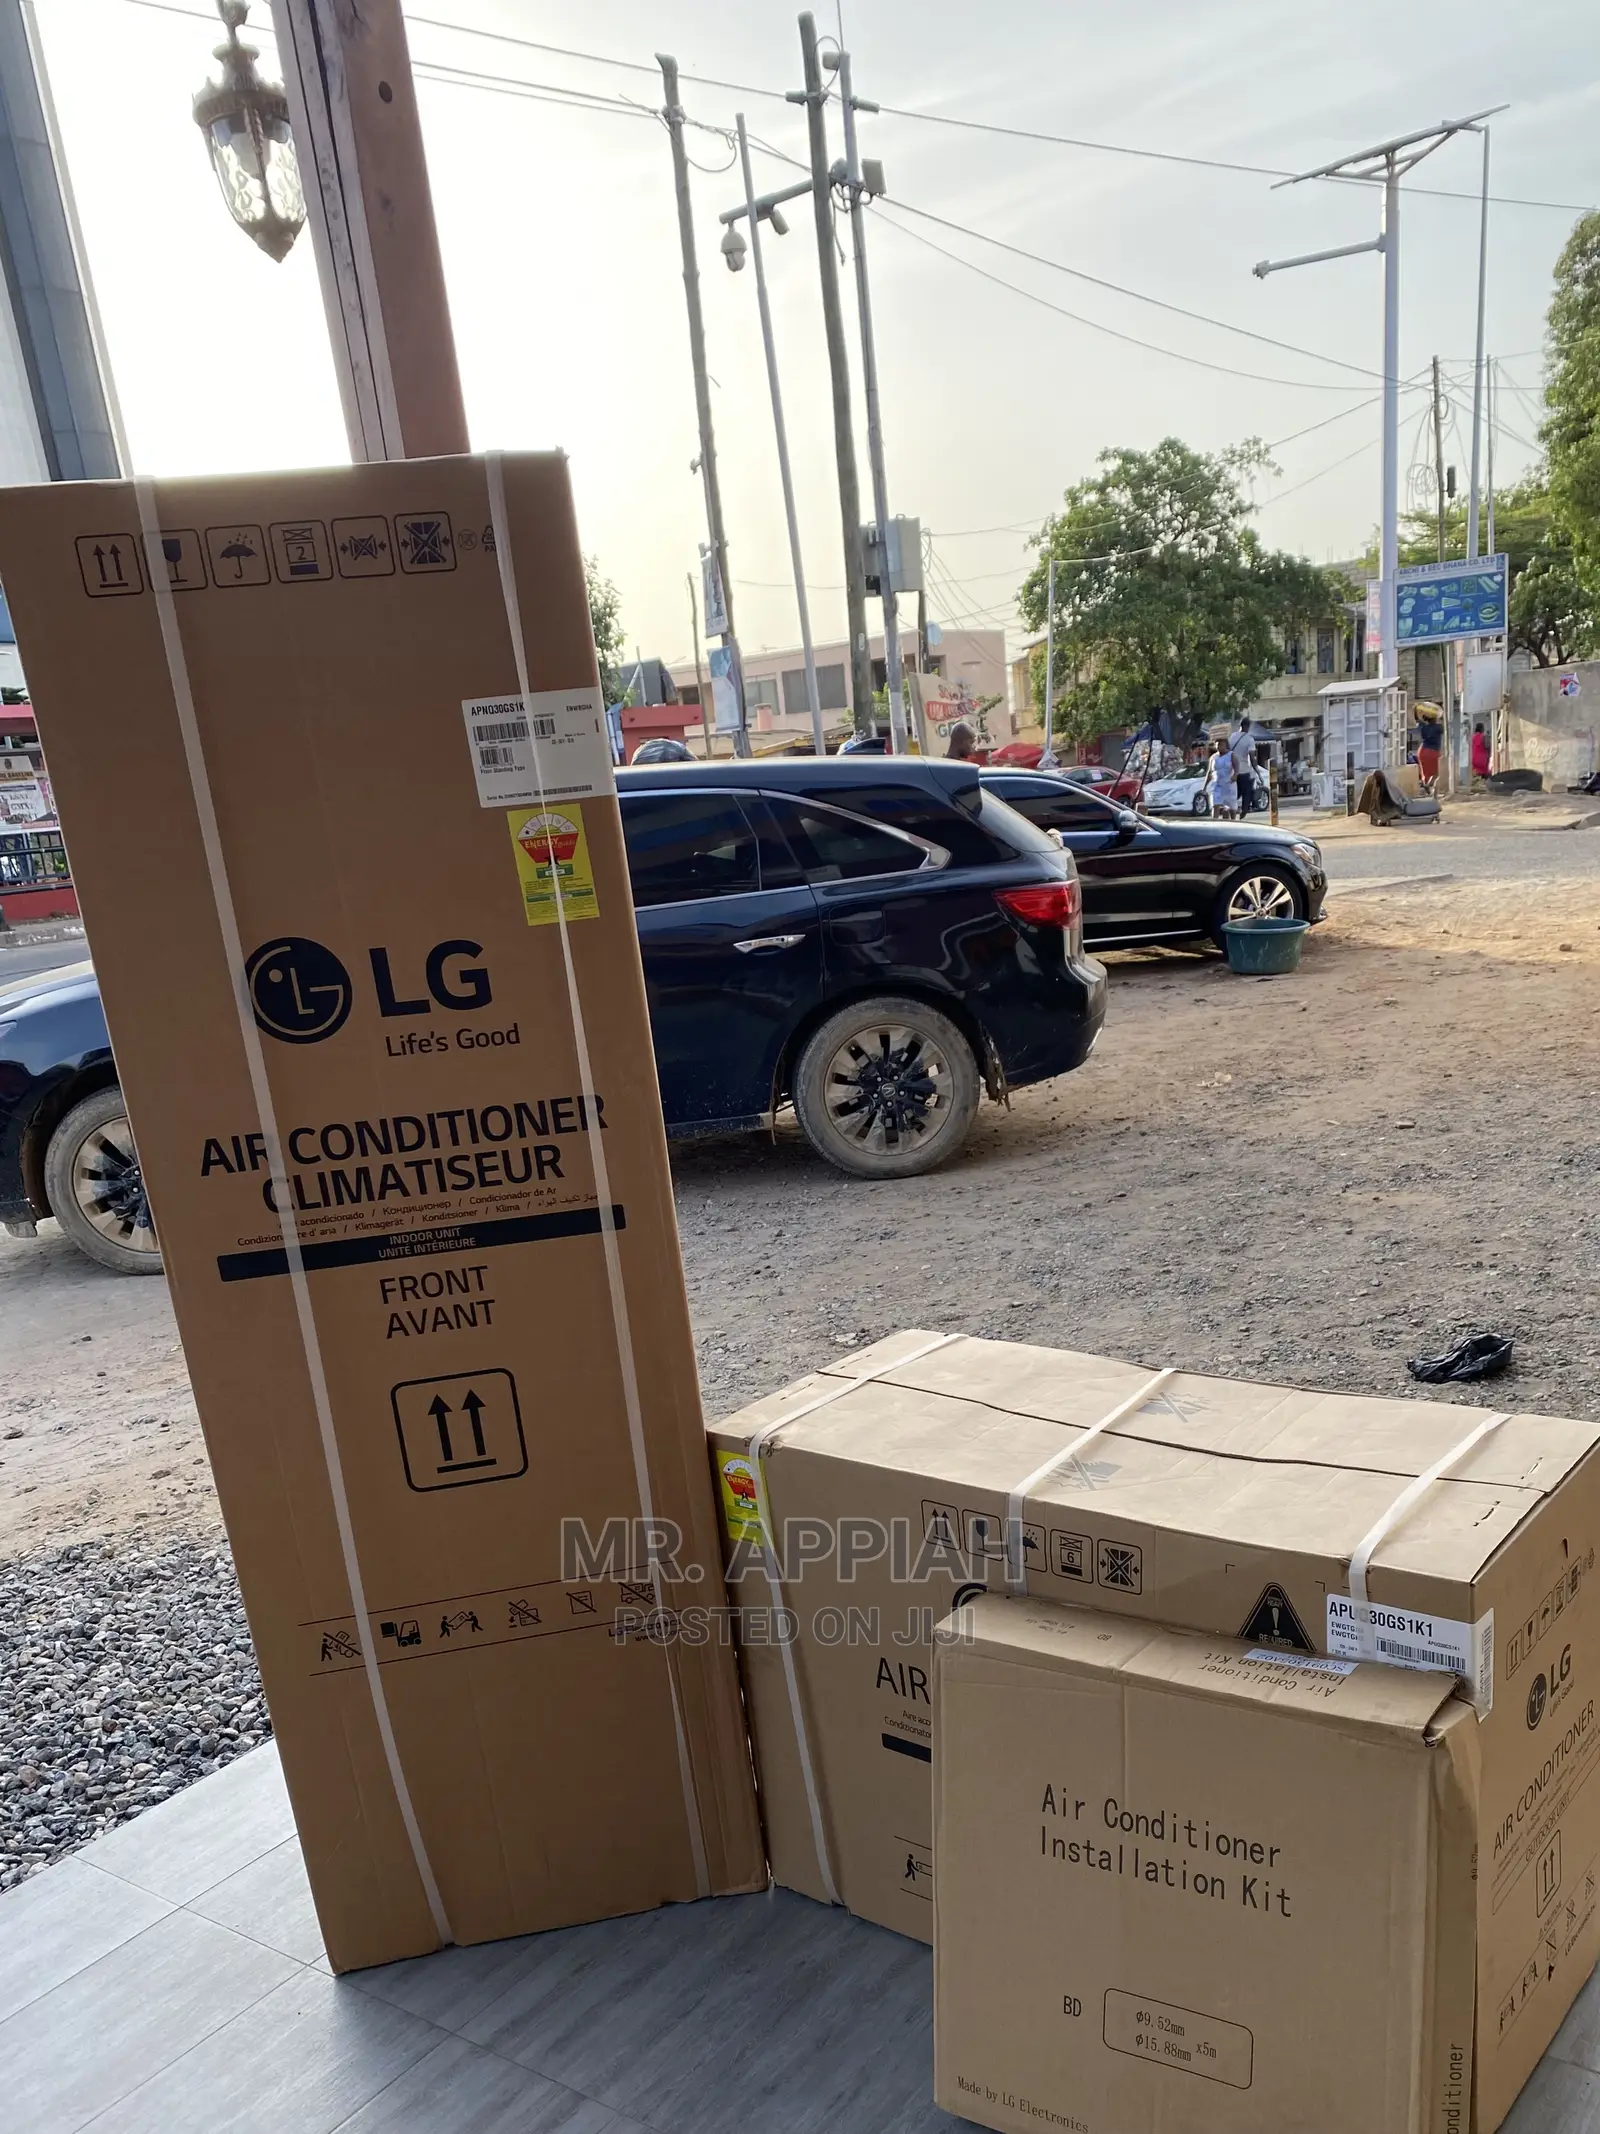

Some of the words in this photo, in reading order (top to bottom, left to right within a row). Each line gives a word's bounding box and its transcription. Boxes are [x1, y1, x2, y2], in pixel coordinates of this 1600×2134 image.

[485, 545, 497, 553] PA
[1443, 560, 1466, 570] GHANA
[525, 837, 560, 850] ENERGY
[369, 939, 493, 1018] LG
[385, 1031, 449, 1057] Life's
[456, 1023, 521, 1051] Good
[200, 1132, 274, 1177] AIR
[289, 1094, 609, 1165] CONDITIONER
[262, 1144, 566, 1214] CLIMATISEUR
[469, 1190, 532, 1206] Condicionador
[533, 1188, 545, 1197] de
[546, 1187, 557, 1196] Ar
[300, 1211, 365, 1228] acondicionado
[355, 1218, 405, 1232] Klimagerät
[422, 1208, 478, 1223] Konditsioner
[495, 1203, 521, 1213] Klima
[378, 1243, 414, 1259] UNITÉ
[415, 1236, 477, 1256] INTÉRIEURE
[389, 1228, 432, 1245] INDOOR
[434, 1226, 461, 1240] UNIT
[379, 1265, 489, 1305] FRONT
[386, 1299, 496, 1339] AVANT
[1066, 1551, 1075, 1564] 6
[1204, 1652, 1233, 1664] Kit
[1238, 1658, 1346, 1686] Installation
[1551, 1643, 1571, 1698] LG
[876, 1657, 931, 1705] AIR
[1198, 1663, 1298, 1692] Conditioner
[1306, 1684, 1337, 1698] Air
[1493, 1812, 1514, 1861] AIR
[1516, 1699, 1594, 1823] CONDITIONER
[1041, 1783, 1087, 1821] Air
[1103, 1797, 1281, 1868] Conditioner
[1040, 1825, 1226, 1902] Installation
[1242, 1875, 1292, 1918] Kit
[1063, 1994, 1082, 2017] BD
[957, 2075, 982, 2096] Made
[985, 2086, 999, 2104] by
[1002, 2091, 1015, 2108] LG
[1019, 2098, 1089, 2134] Electronics
